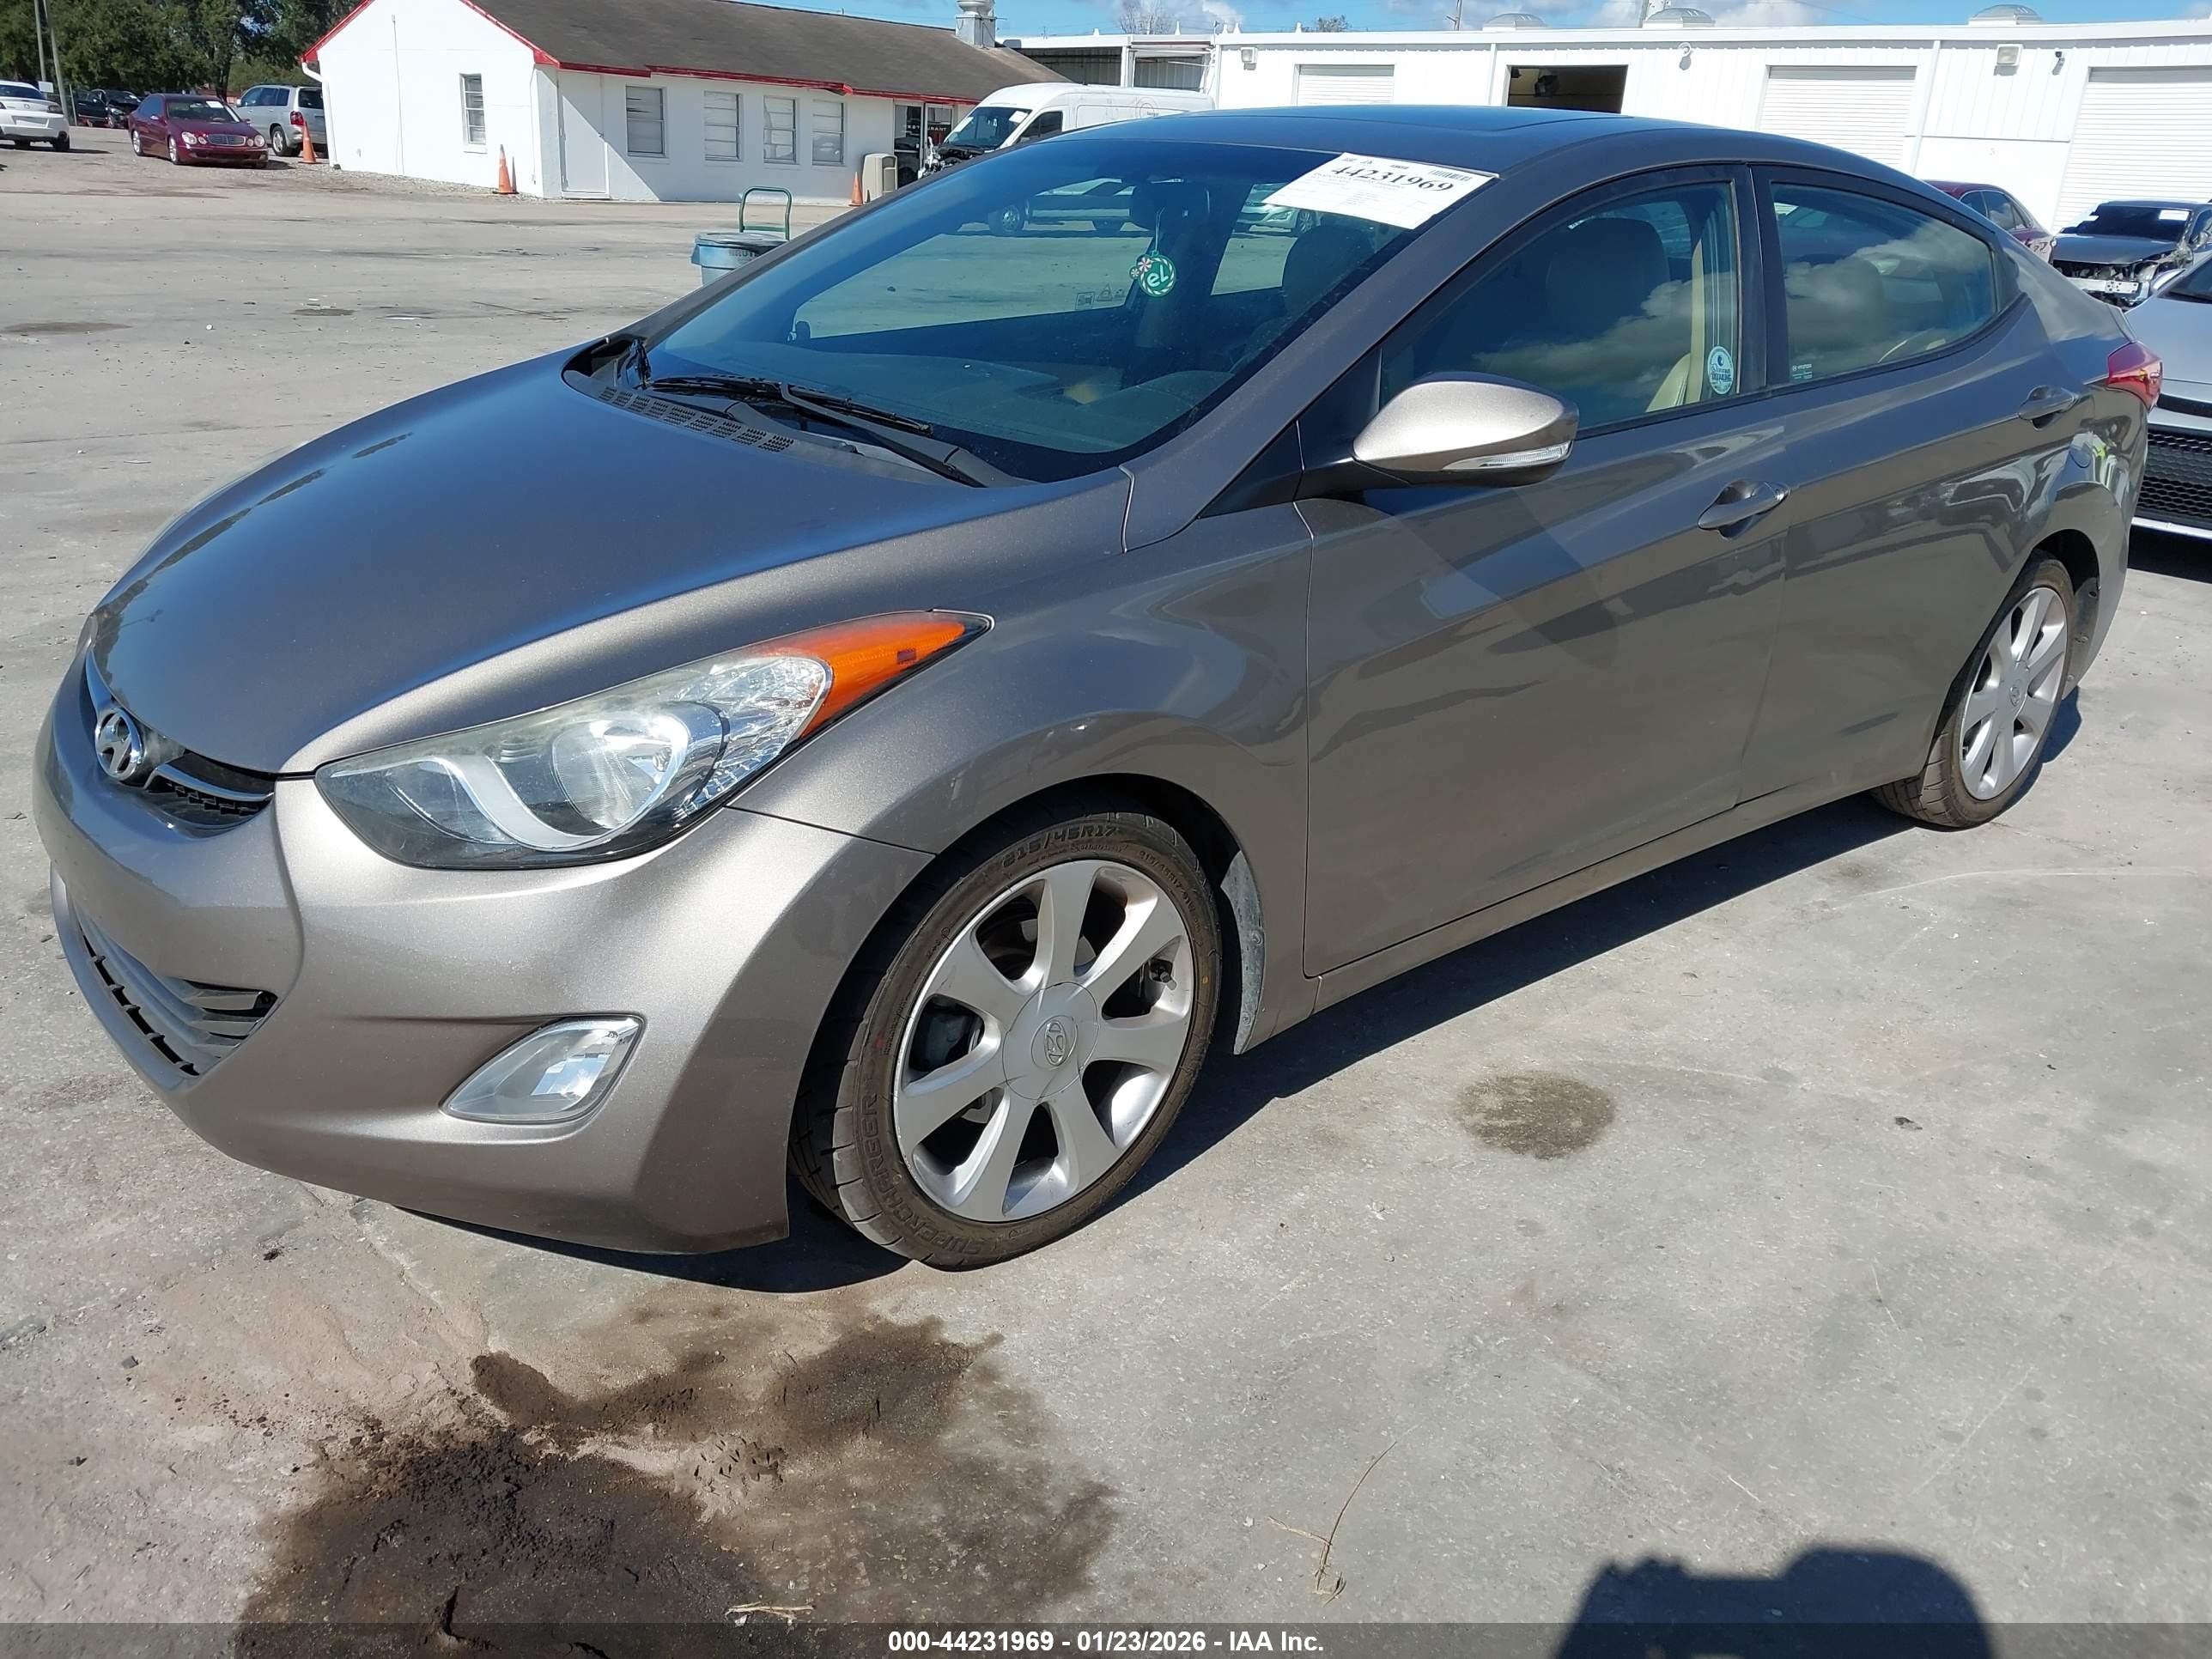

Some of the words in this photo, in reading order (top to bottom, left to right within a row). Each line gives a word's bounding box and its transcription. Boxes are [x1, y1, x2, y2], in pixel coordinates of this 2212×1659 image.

[1331, 166, 1455, 191] 44231969
[1002, 826, 1116, 867] 215/45R17
[860, 1091, 982, 1255] SUPERCHARGER
